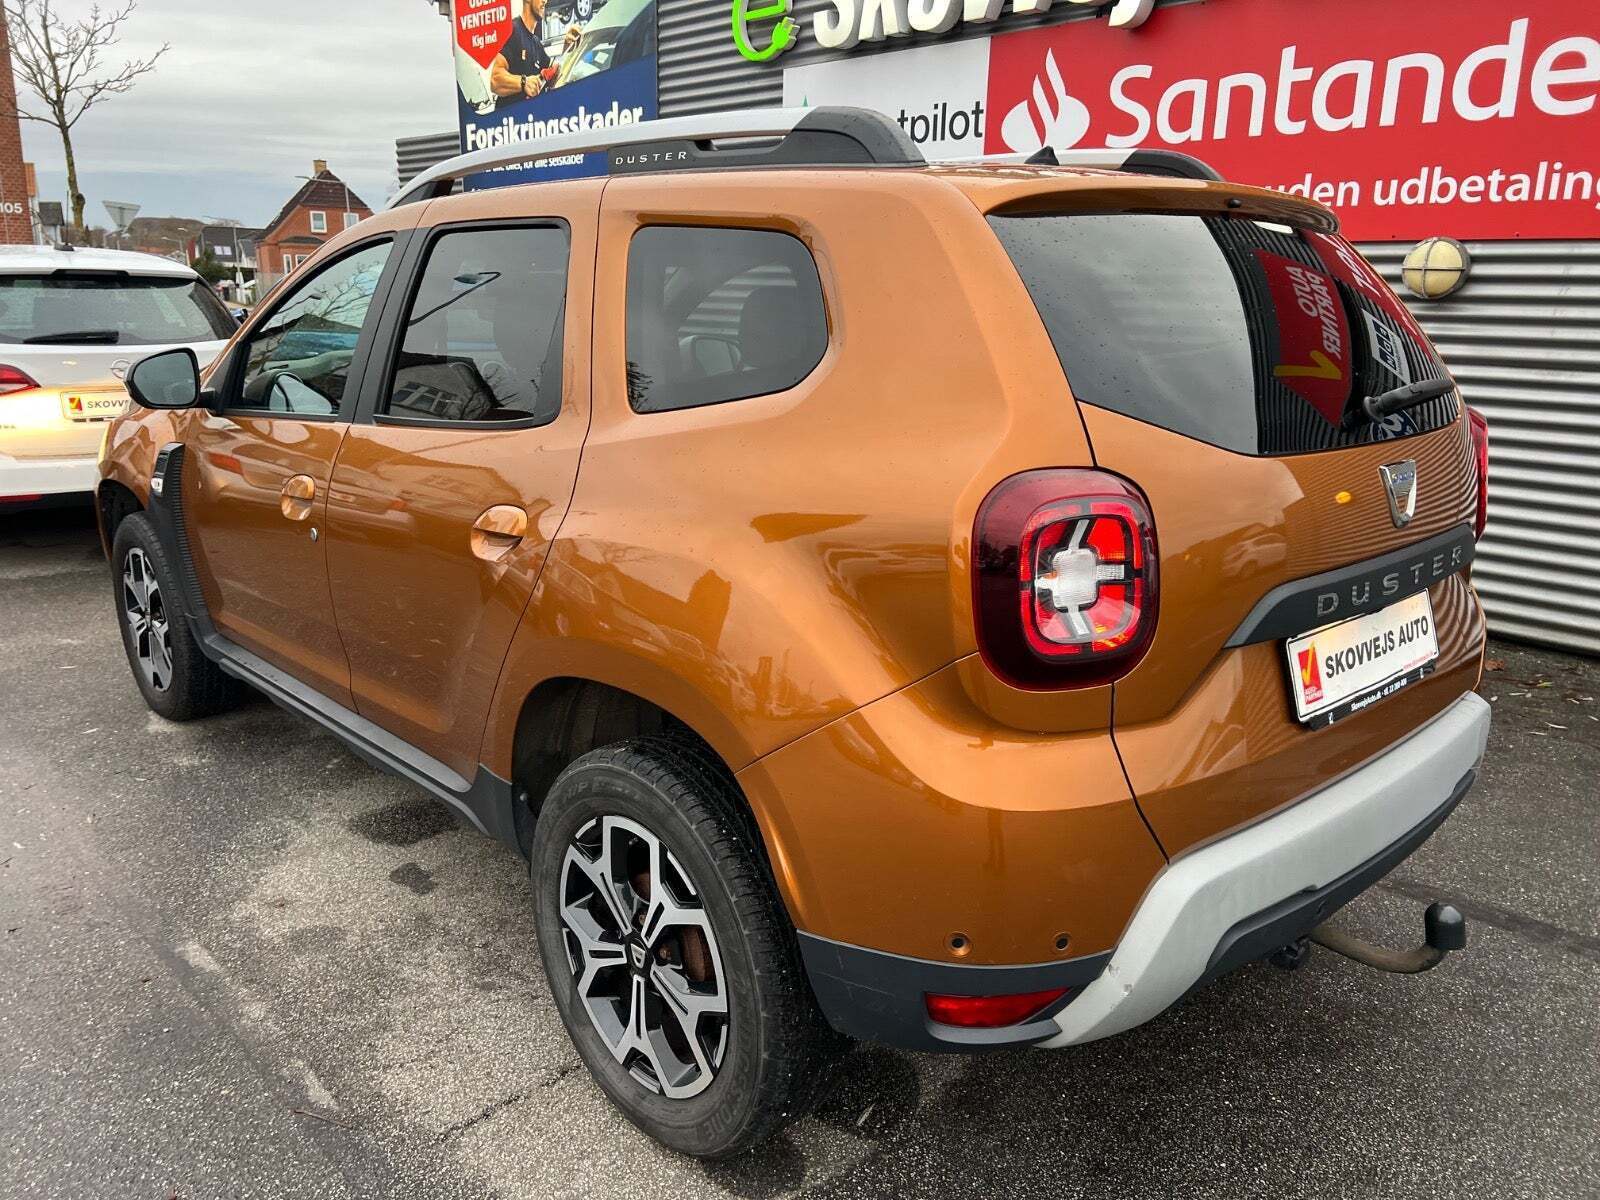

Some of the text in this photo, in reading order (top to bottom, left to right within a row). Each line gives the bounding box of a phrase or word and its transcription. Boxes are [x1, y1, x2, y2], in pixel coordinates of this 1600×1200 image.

[460, 6, 507, 30] VENTETID
[471, 30, 497, 48] Kig ind
[897, 101, 984, 144] tpilot
[615, 151, 687, 165] DUSTER
[1264, 172, 1361, 207] den
[1317, 545, 1463, 617] DUSTER
[1325, 630, 1395, 679] SKOVVEJS
[1398, 615, 1429, 647] AUTO
